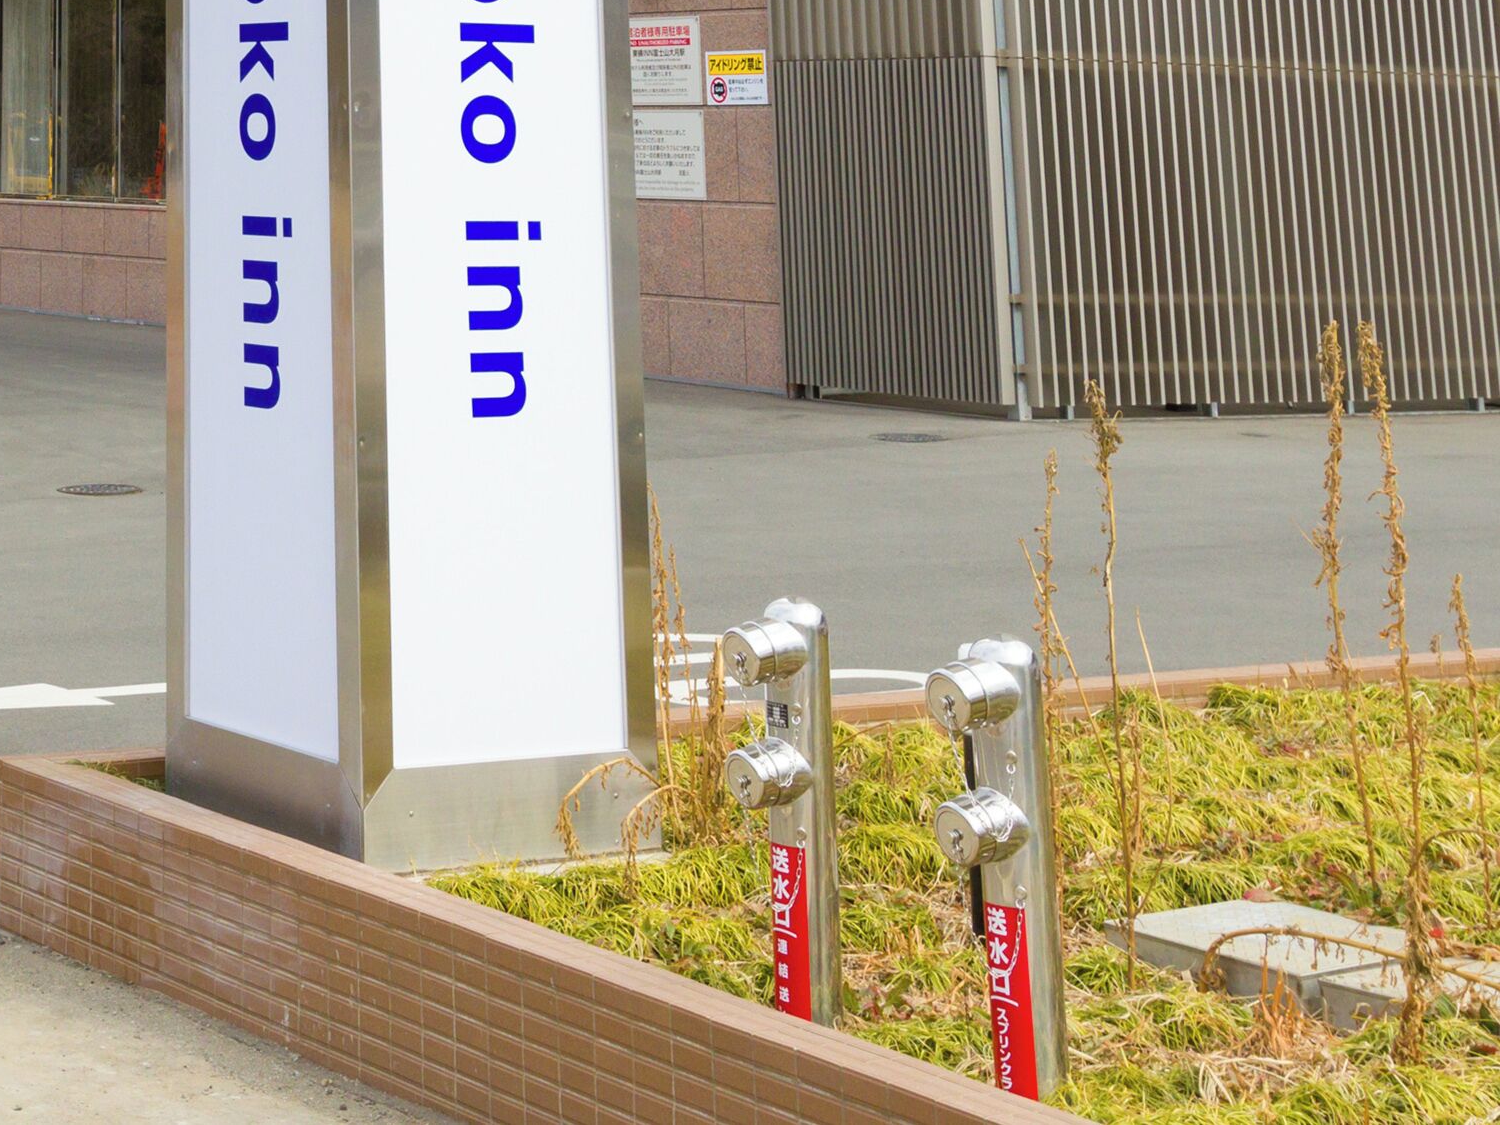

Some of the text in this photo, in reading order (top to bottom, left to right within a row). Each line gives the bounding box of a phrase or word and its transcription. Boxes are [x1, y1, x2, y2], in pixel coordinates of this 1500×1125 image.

[709, 56, 763, 72] アイドリング禁止
[241, 214, 293, 410] inn
[465, 220, 542, 419] inn
